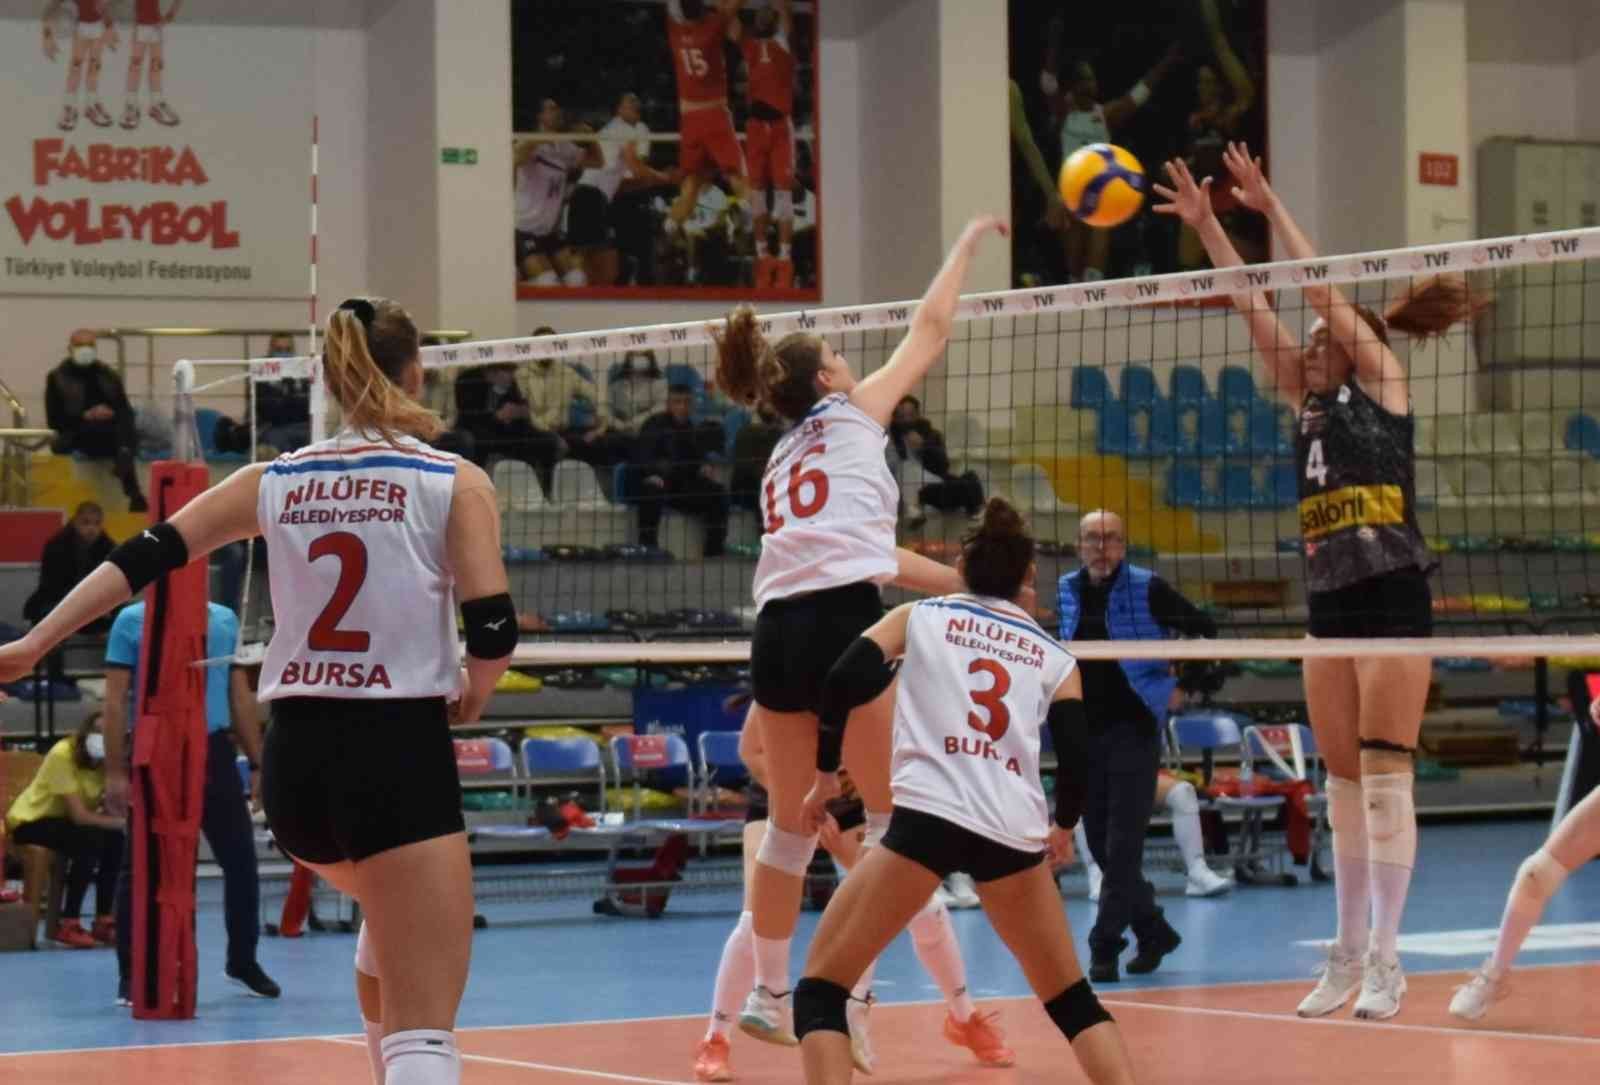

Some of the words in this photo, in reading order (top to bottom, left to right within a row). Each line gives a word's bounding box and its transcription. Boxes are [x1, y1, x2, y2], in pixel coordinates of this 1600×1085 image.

[680, 47, 708, 77] 15
[5, 194, 240, 249] VOLEYBOL
[6, 257, 64, 280] Türkiye
[70, 258, 141, 282] Voleybol
[148, 260, 252, 283] Federasyonu
[842, 313, 861, 326] TVF
[888, 309, 907, 321] TVF
[983, 298, 1004, 312] TVF
[1033, 294, 1055, 307] TVF
[1084, 288, 1106, 302] TVF
[1136, 282, 1159, 297] TVF
[1191, 276, 1214, 291] TVF
[1246, 271, 1271, 287] TVF
[1304, 265, 1328, 280] TVF
[1363, 258, 1388, 274] TVF
[1424, 251, 1450, 268] TVF
[1487, 244, 1513, 261] TVF
[1551, 239, 1579, 256] TVF
[1306, 438, 1328, 487] 4
[284, 475, 407, 511] NİLÜFER
[766, 443, 829, 534] 16
[279, 507, 405, 525] BELEDİYESPOR
[307, 531, 370, 653] 2
[945, 633, 1043, 670] BELEDİYESPOR
[946, 618, 1045, 660] NİLÜFER
[280, 662, 392, 689] BURSA
[967, 657, 1011, 743] 3
[944, 736, 1022, 776] BURA
